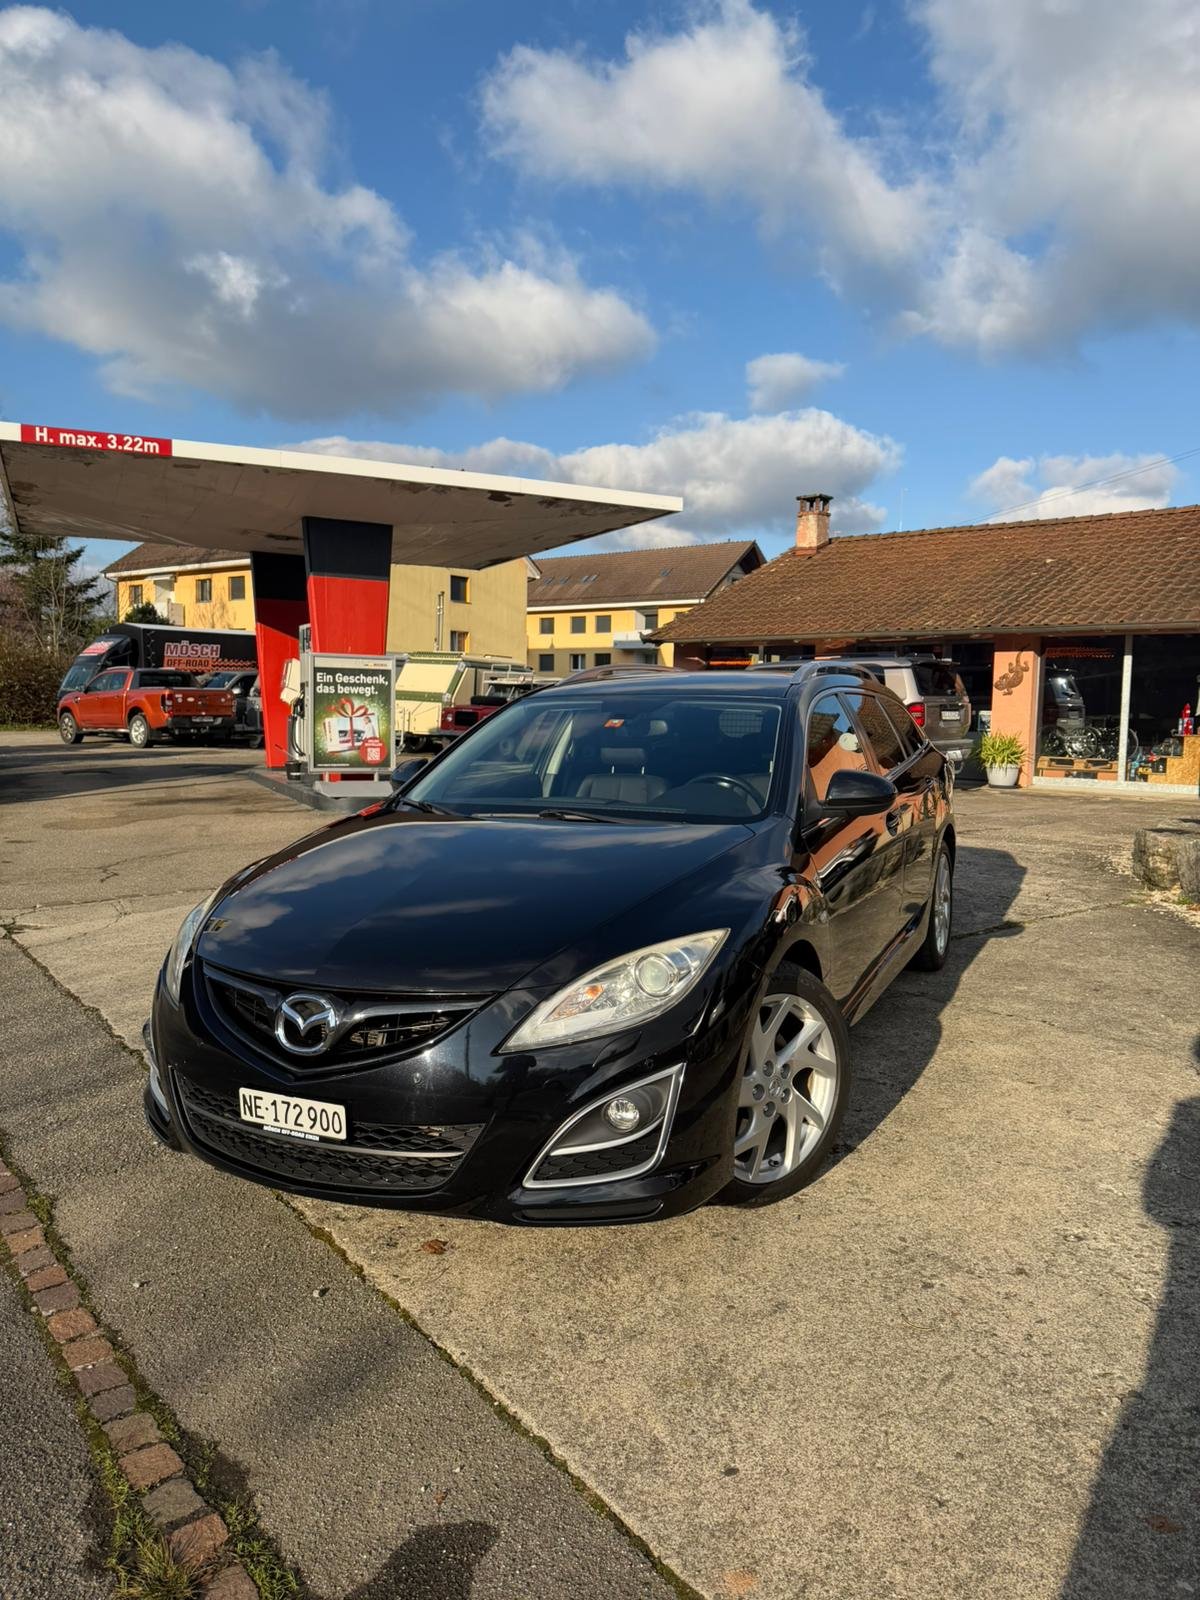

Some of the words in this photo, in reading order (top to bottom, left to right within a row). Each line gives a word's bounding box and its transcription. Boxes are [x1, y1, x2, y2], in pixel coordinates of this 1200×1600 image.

[35, 427, 54, 443] H.
[59, 432, 102, 448] max.
[107, 434, 160, 453] 3.22m
[164, 640, 221, 657] MÖSCH
[166, 658, 210, 668] OFF-ROAD
[316, 672, 333, 682] Ein
[335, 673, 389, 686] Geschenk,
[316, 683, 335, 693] das
[337, 684, 379, 697] bewegt.
